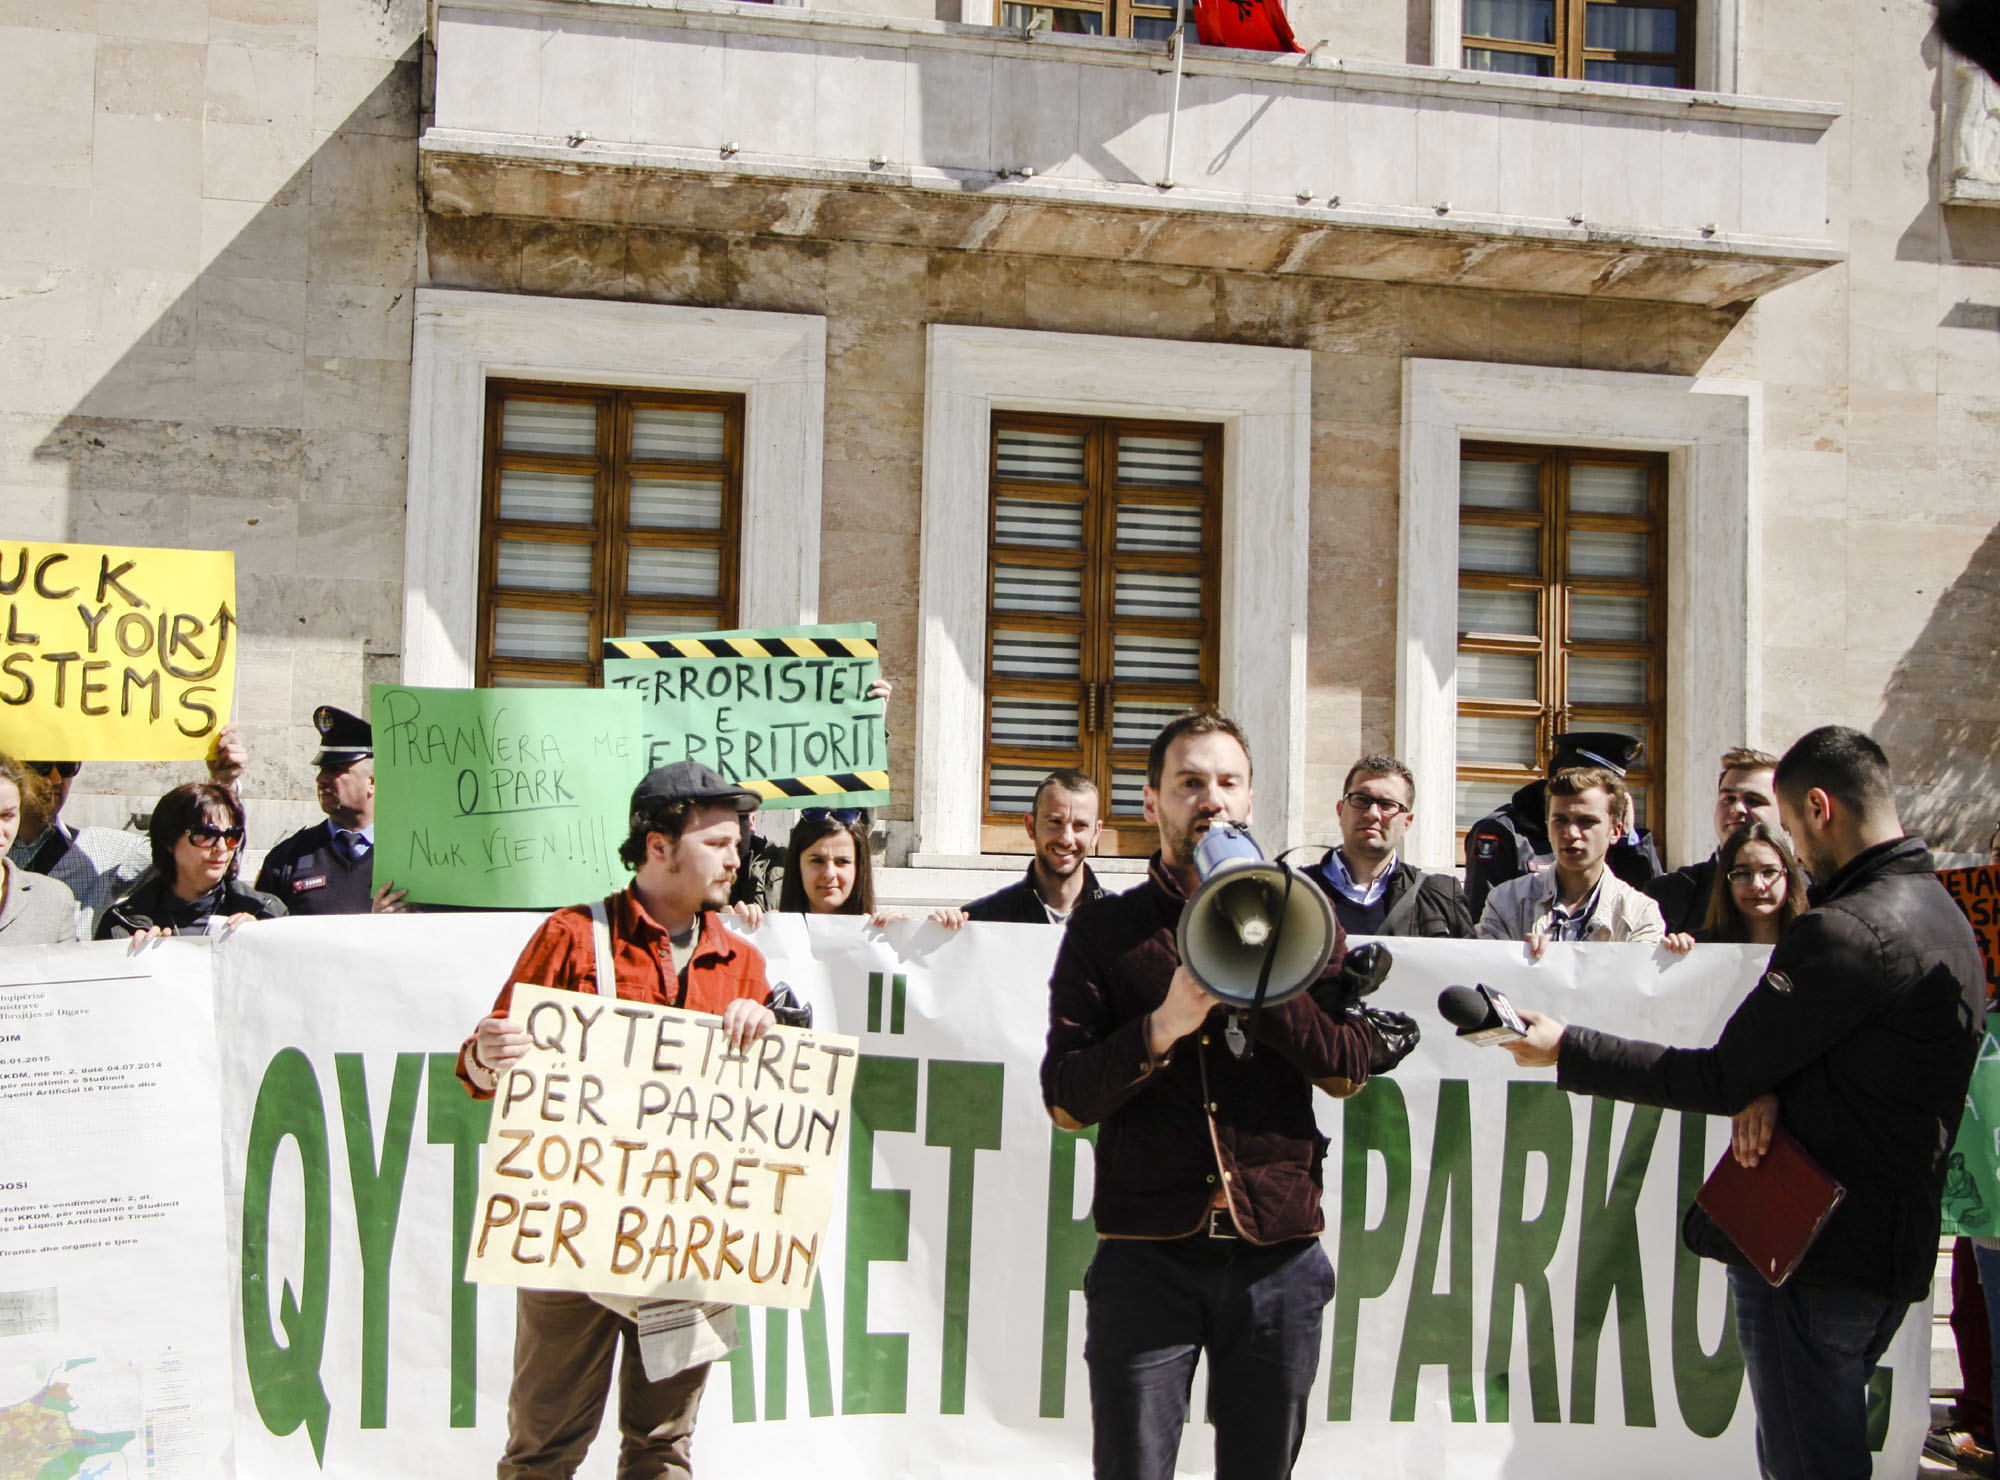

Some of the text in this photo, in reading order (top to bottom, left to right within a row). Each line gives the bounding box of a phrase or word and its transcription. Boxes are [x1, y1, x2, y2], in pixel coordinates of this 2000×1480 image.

[0, 651, 216, 738] STEMS
[716, 706, 739, 733] E
[490, 767, 575, 808] PARK
[526, 1000, 855, 1096] QYTETARËT
[107, 1061, 163, 1072] 04.07.2014
[21, 1078, 70, 1088] miratimin
[82, 1074, 125, 1083] Studimit
[36, 1086, 81, 1096] Artificial
[502, 1061, 840, 1156] PËR PARKUN
[496, 1128, 809, 1215] ZORTARËT
[18, 1212, 53, 1221] KKDM,
[76, 1205, 125, 1216] miratimin
[137, 1201, 180, 1210] Studimit
[53, 1199, 107, 1208] vendimeve
[28, 1220, 64, 1230] Liqenit
[67, 1216, 112, 1226] Artificial
[62, 1241, 102, 1251] organet
[476, 1189, 820, 1289] PËR BARKUN
[1326, 1075, 1894, 1452] PARKU
